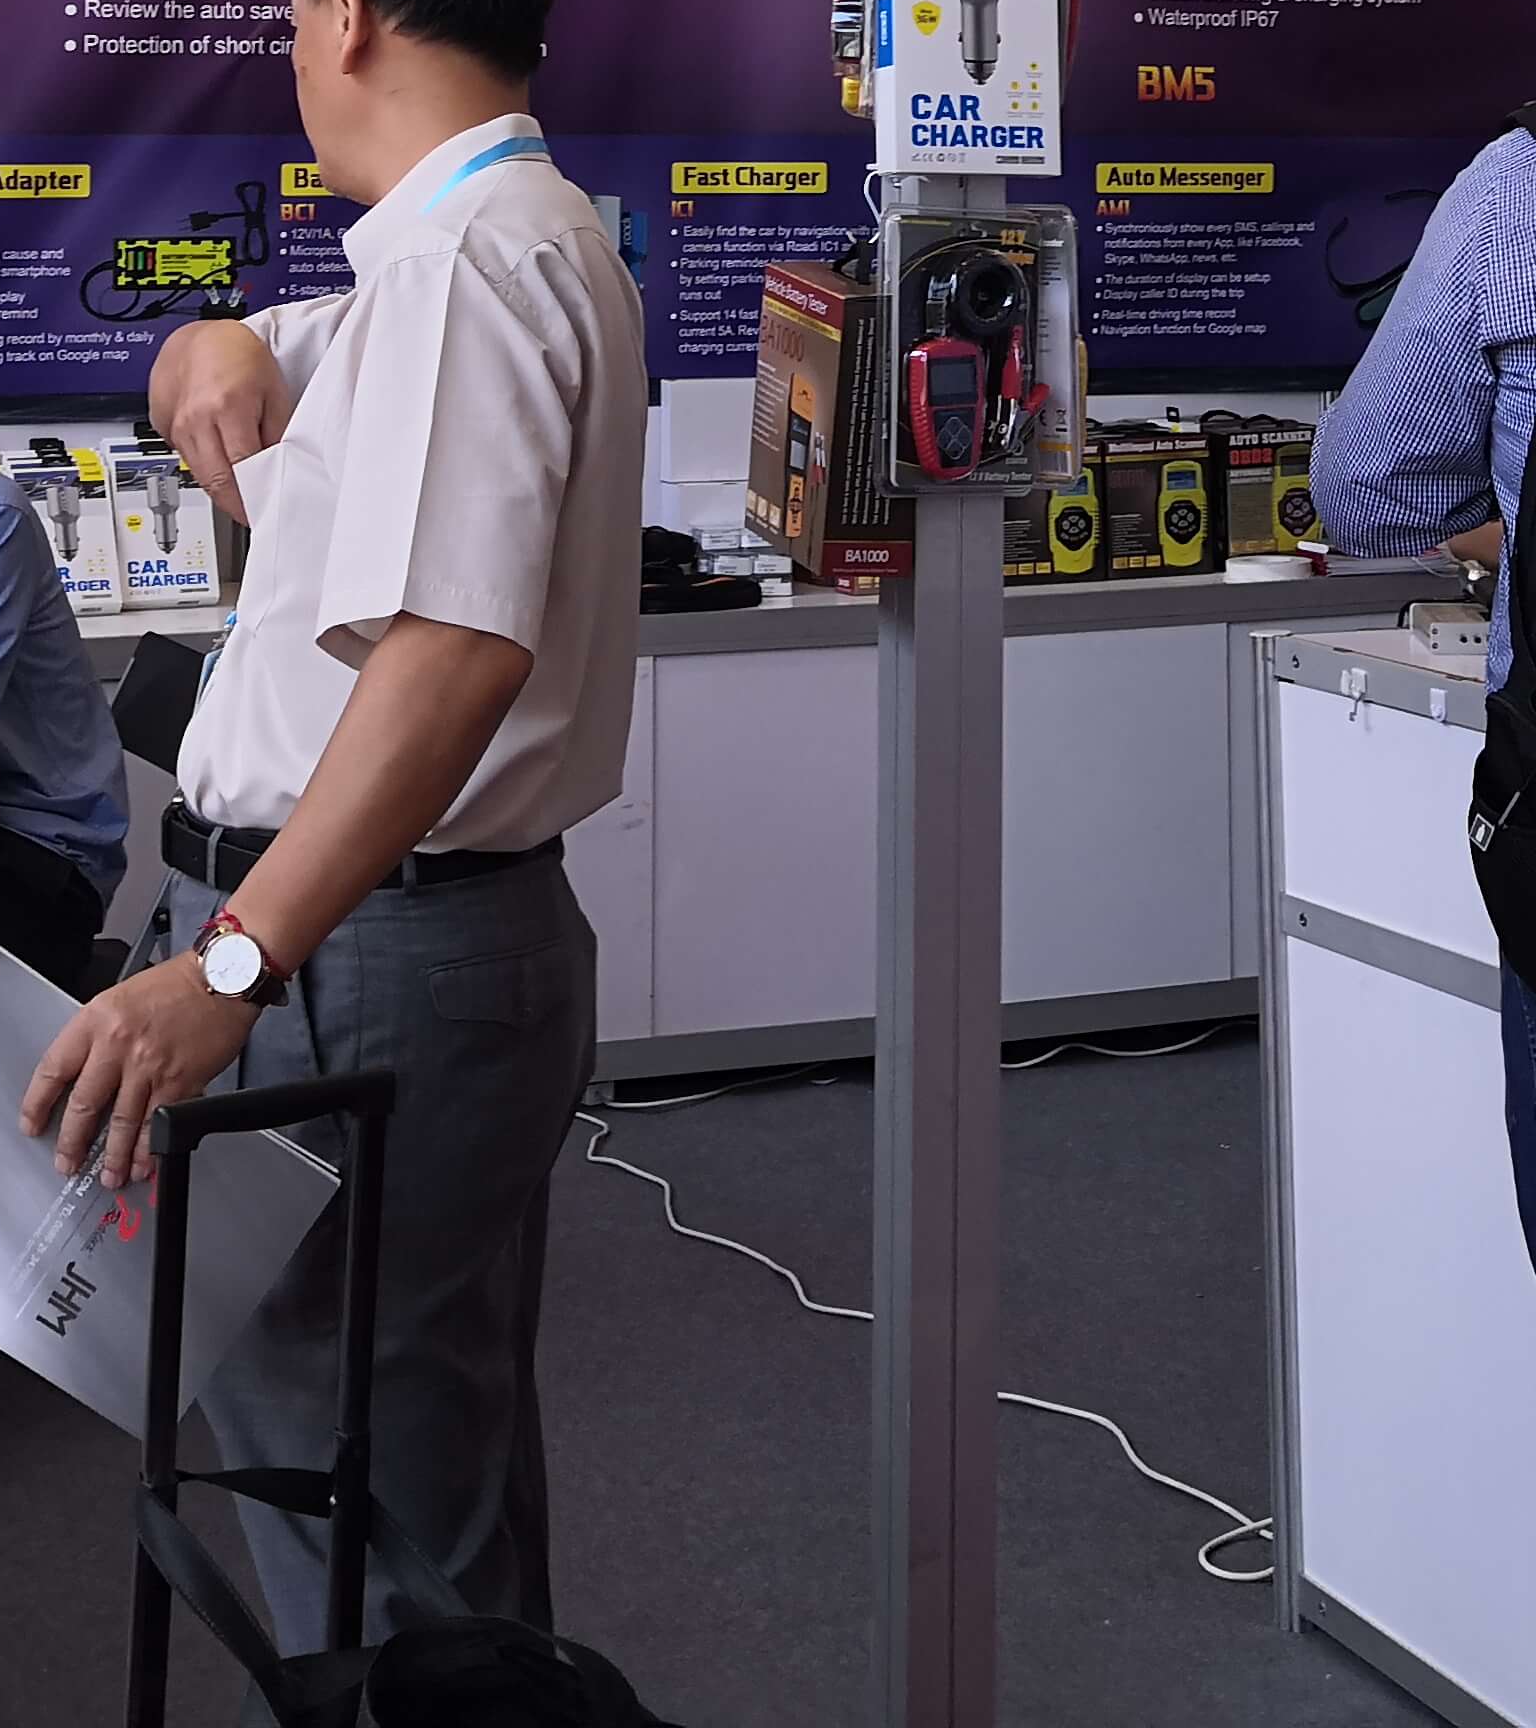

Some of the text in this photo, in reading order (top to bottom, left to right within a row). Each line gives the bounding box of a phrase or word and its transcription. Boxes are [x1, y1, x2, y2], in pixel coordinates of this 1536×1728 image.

[1148, 9, 1279, 30] Waterproof IP67
[1137, 65, 1216, 104] BM5
[911, 93, 981, 121] CAR
[911, 124, 1045, 149] CHARGER
[684, 167, 820, 190] Fast Charger
[1107, 167, 1265, 190] Auto Messenger
[3, 250, 38, 259] cause
[41, 247, 64, 259] and
[1229, 430, 1313, 446] AUTO SCANNER
[845, 550, 890, 563] BA1000
[128, 559, 169, 574] CAR
[64, 579, 112, 593] RGER
[128, 572, 209, 588] CHARGER
